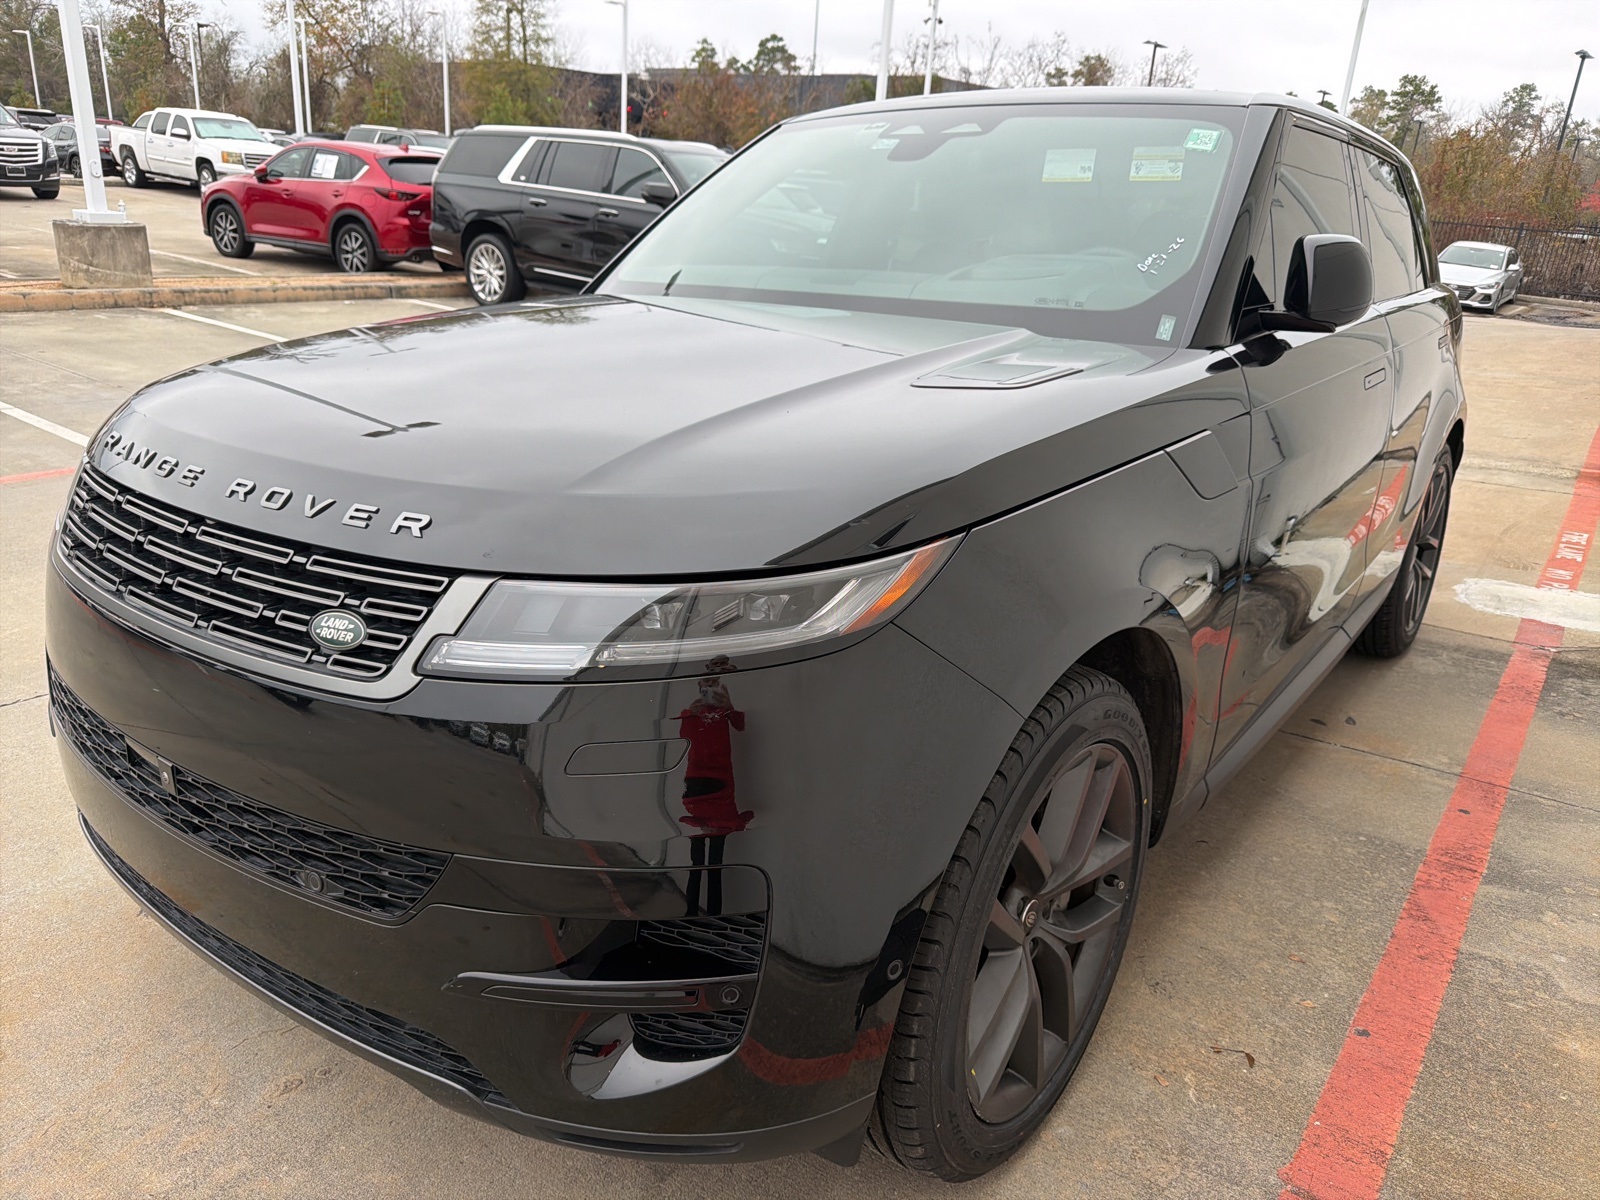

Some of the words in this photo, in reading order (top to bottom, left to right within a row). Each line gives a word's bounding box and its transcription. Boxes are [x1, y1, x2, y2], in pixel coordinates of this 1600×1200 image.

[103, 430, 206, 487] RANGE
[224, 477, 433, 538] ROVER
[1555, 543, 1586, 562] LANE
[1545, 567, 1575, 580] NO
[320, 616, 349, 630] LAND
[319, 627, 354, 643] ROVER
